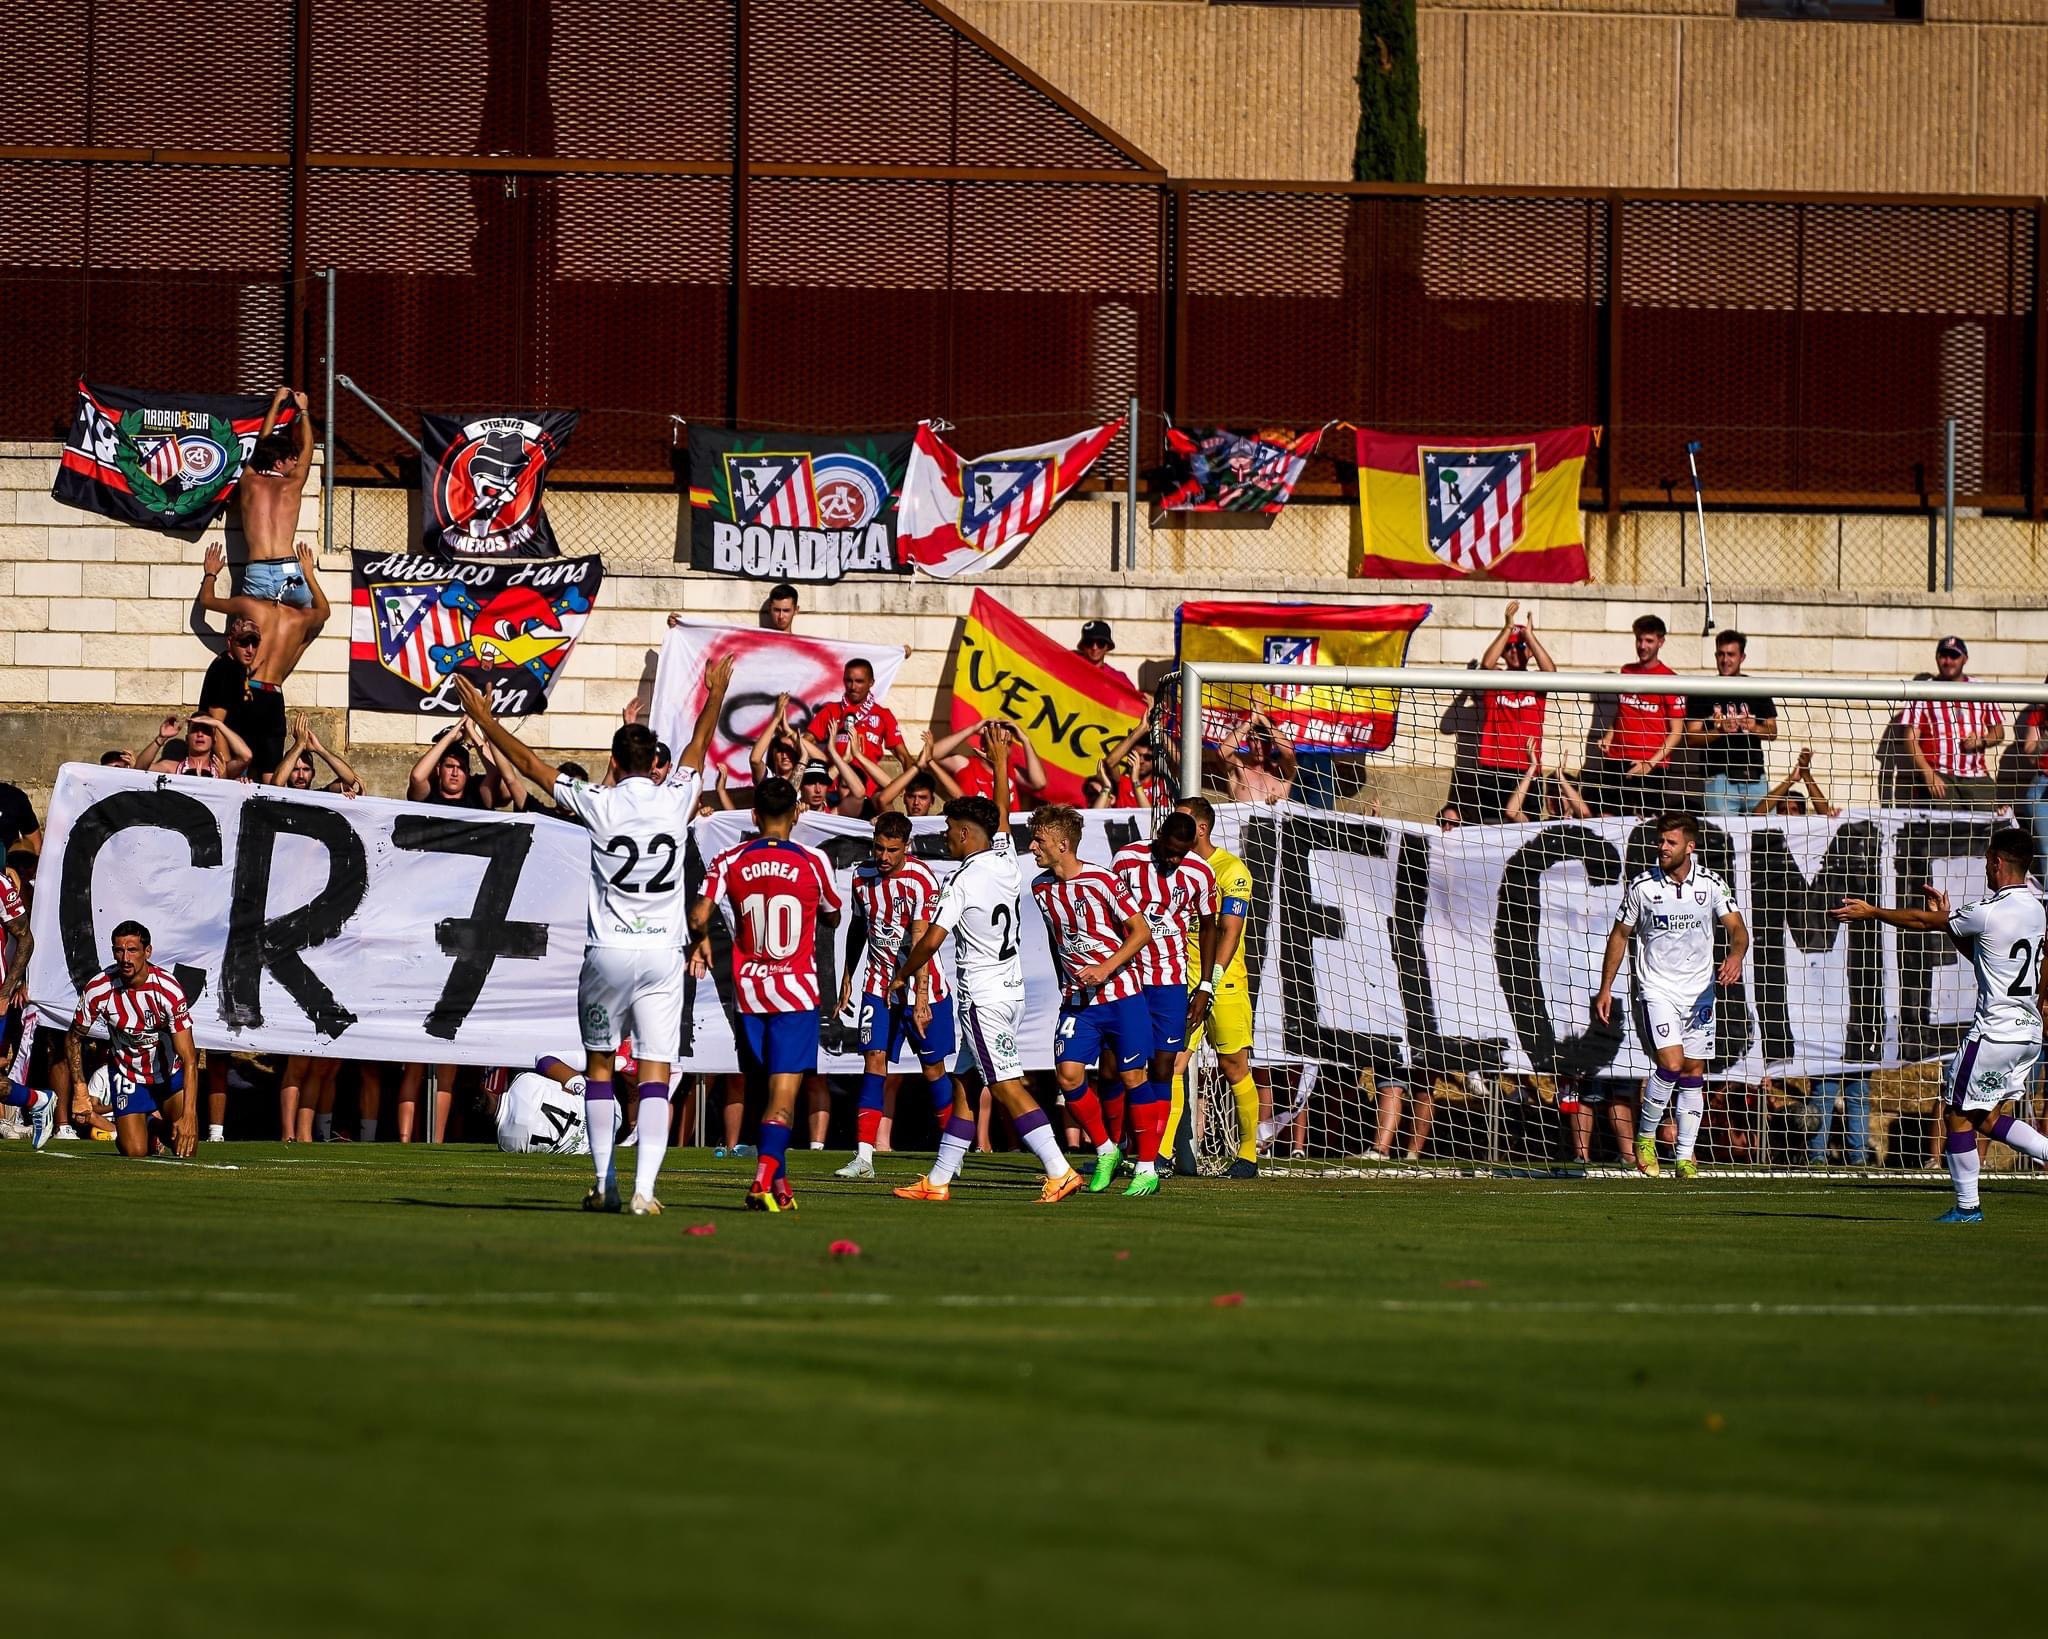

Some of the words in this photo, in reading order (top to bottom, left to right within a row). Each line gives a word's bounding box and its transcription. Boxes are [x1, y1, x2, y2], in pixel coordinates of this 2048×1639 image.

[143, 408, 181, 428] MADRID
[419, 672, 529, 714] Lón
[606, 832, 678, 893] 22
[741, 861, 799, 883] CORREA
[740, 893, 802, 960] 10
[1669, 913, 1694, 923] Grupo
[1669, 919, 1702, 931] Herce
[862, 1005, 874, 1028] 2
